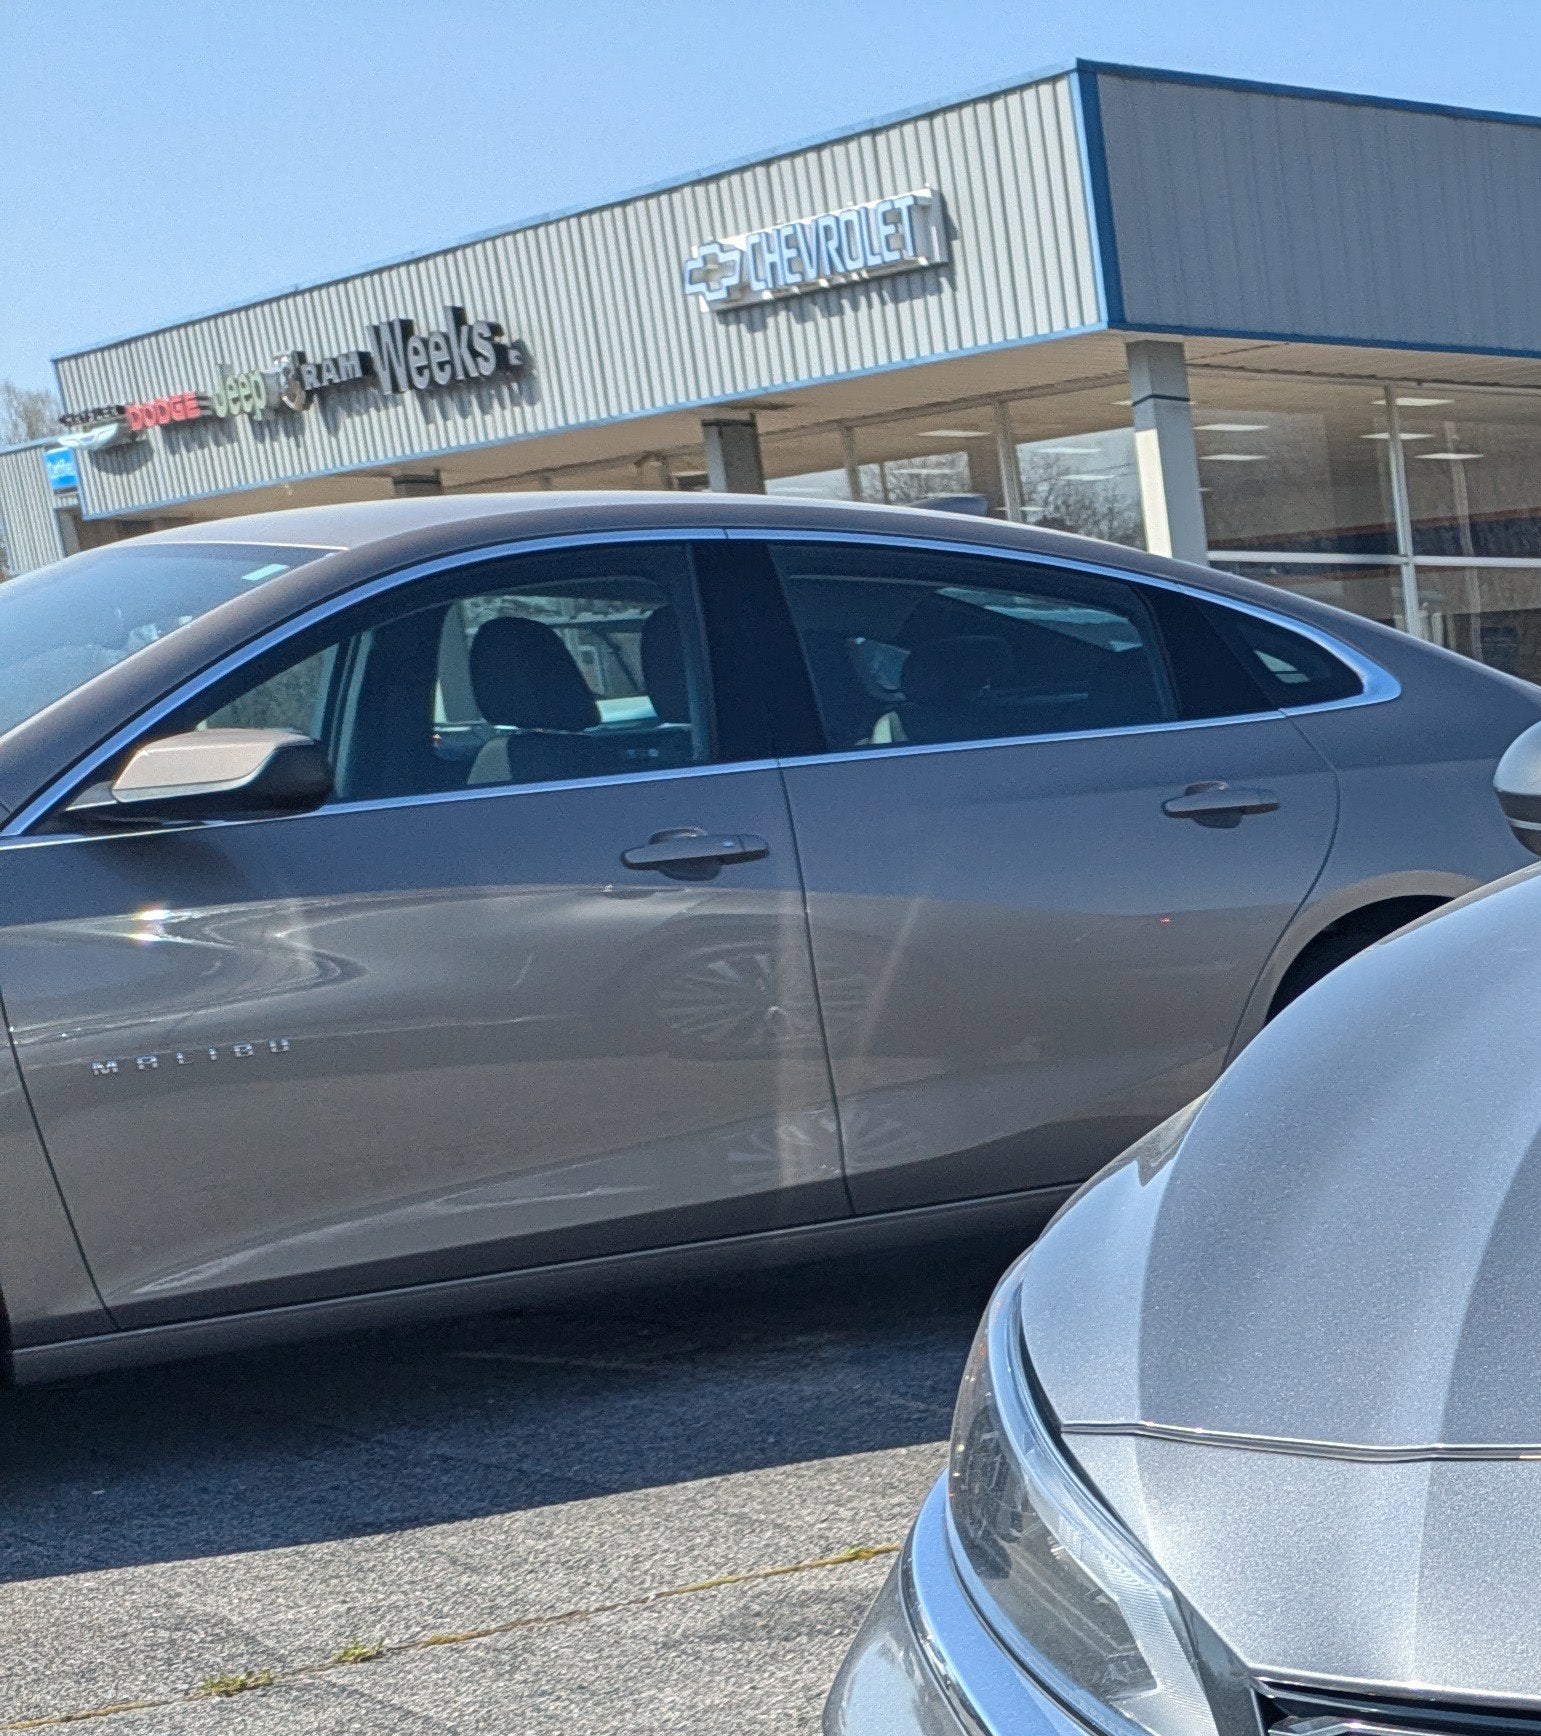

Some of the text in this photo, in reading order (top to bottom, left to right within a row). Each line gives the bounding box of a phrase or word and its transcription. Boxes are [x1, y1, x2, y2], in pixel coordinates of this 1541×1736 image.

[745, 195, 915, 291] CHEVROLET
[301, 351, 363, 391] RAM
[366, 305, 497, 396] Weeks
[126, 391, 200, 431] DODGE
[214, 371, 266, 421] Jeep
